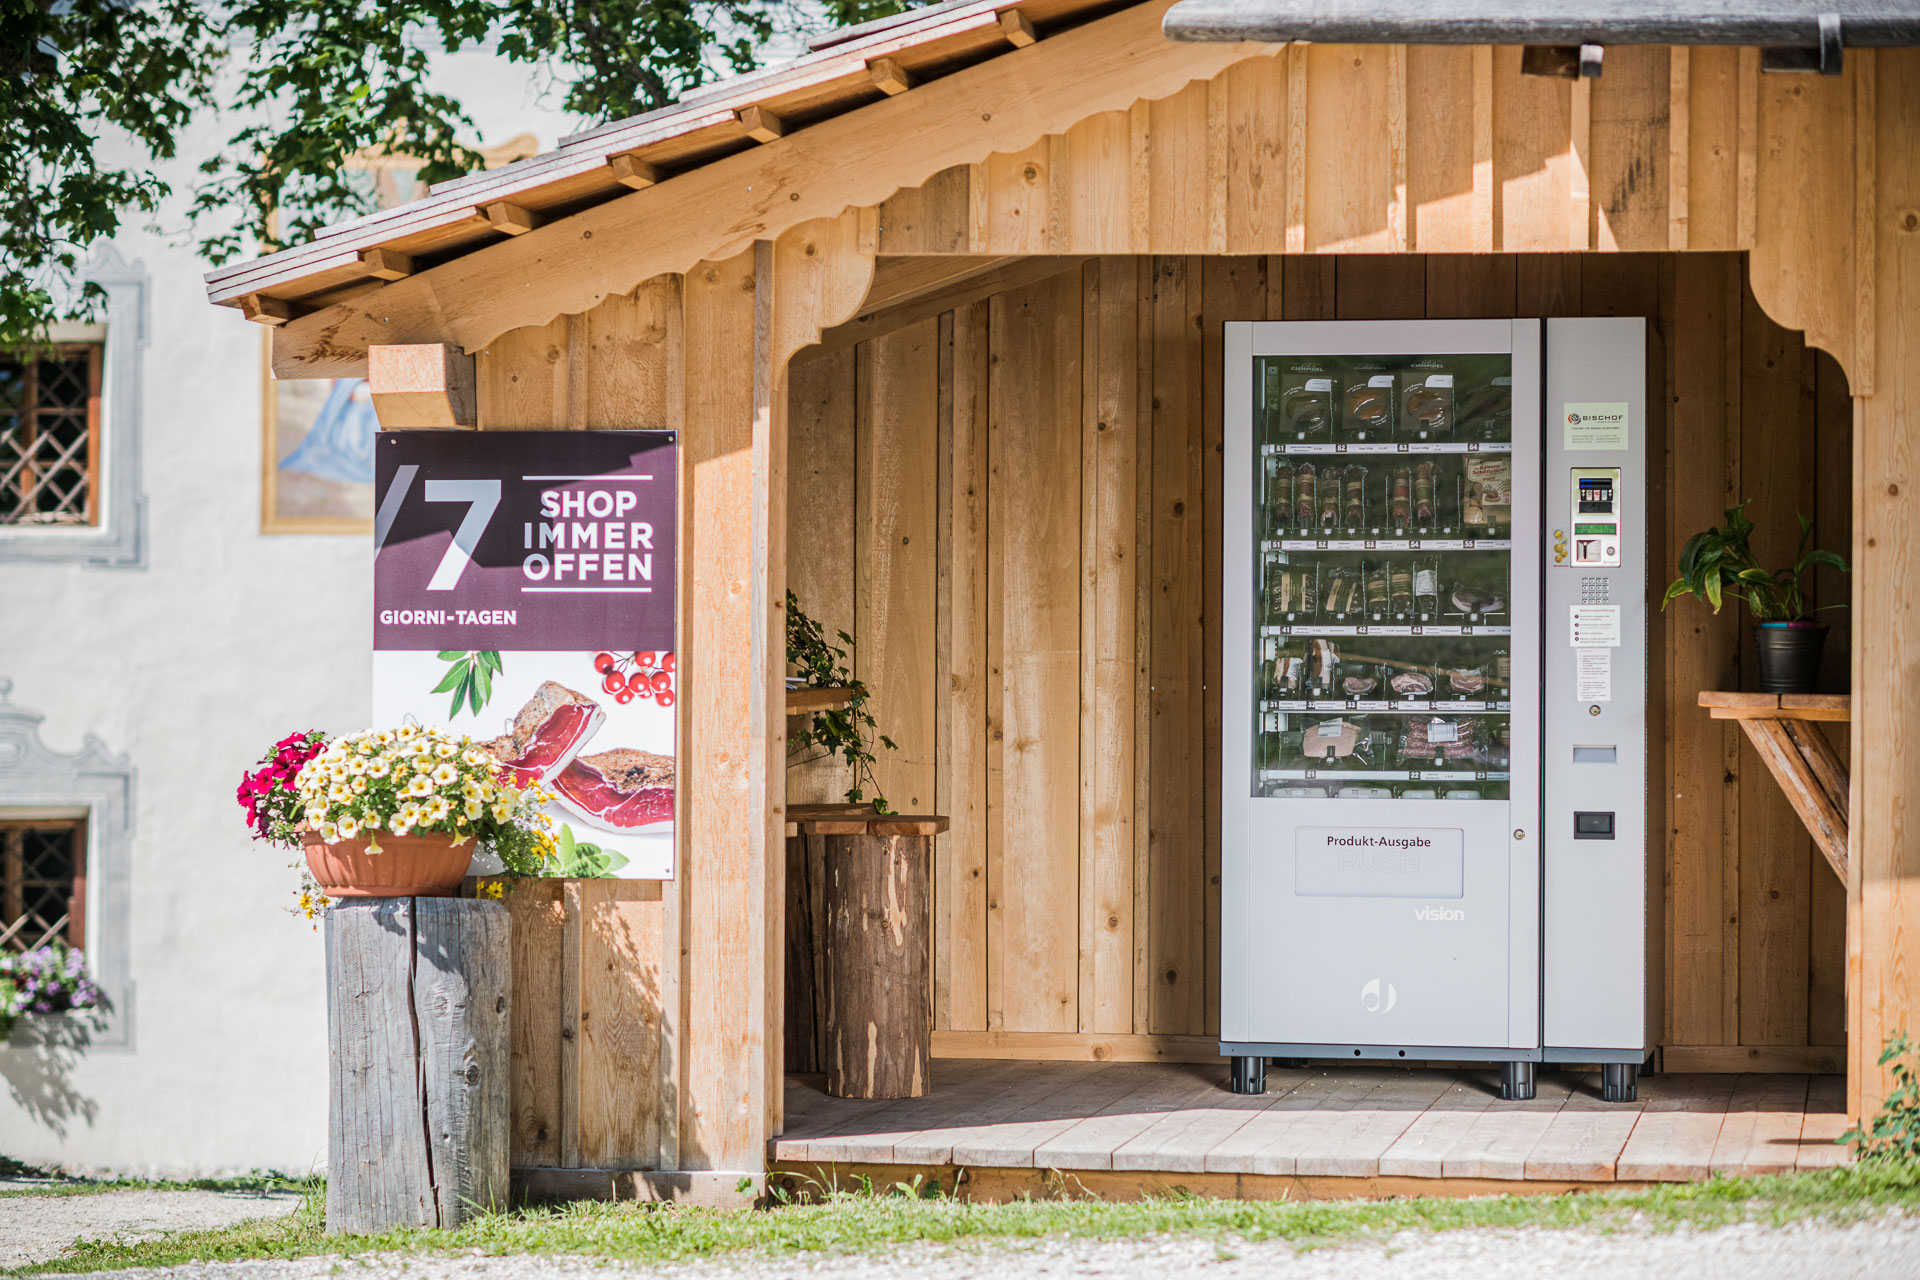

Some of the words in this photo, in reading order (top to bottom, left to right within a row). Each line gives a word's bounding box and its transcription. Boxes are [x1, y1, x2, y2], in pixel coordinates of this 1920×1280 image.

[539, 490, 638, 518] SHOP
[524, 522, 654, 549] IMMER
[522, 553, 652, 581] OFFEN
[379, 610, 517, 625] GIORNI-TAGEN
[1327, 836, 1431, 849] Produkt-Ausgabe
[1338, 850, 1421, 874] PUSH
[1414, 906, 1465, 921] vision
